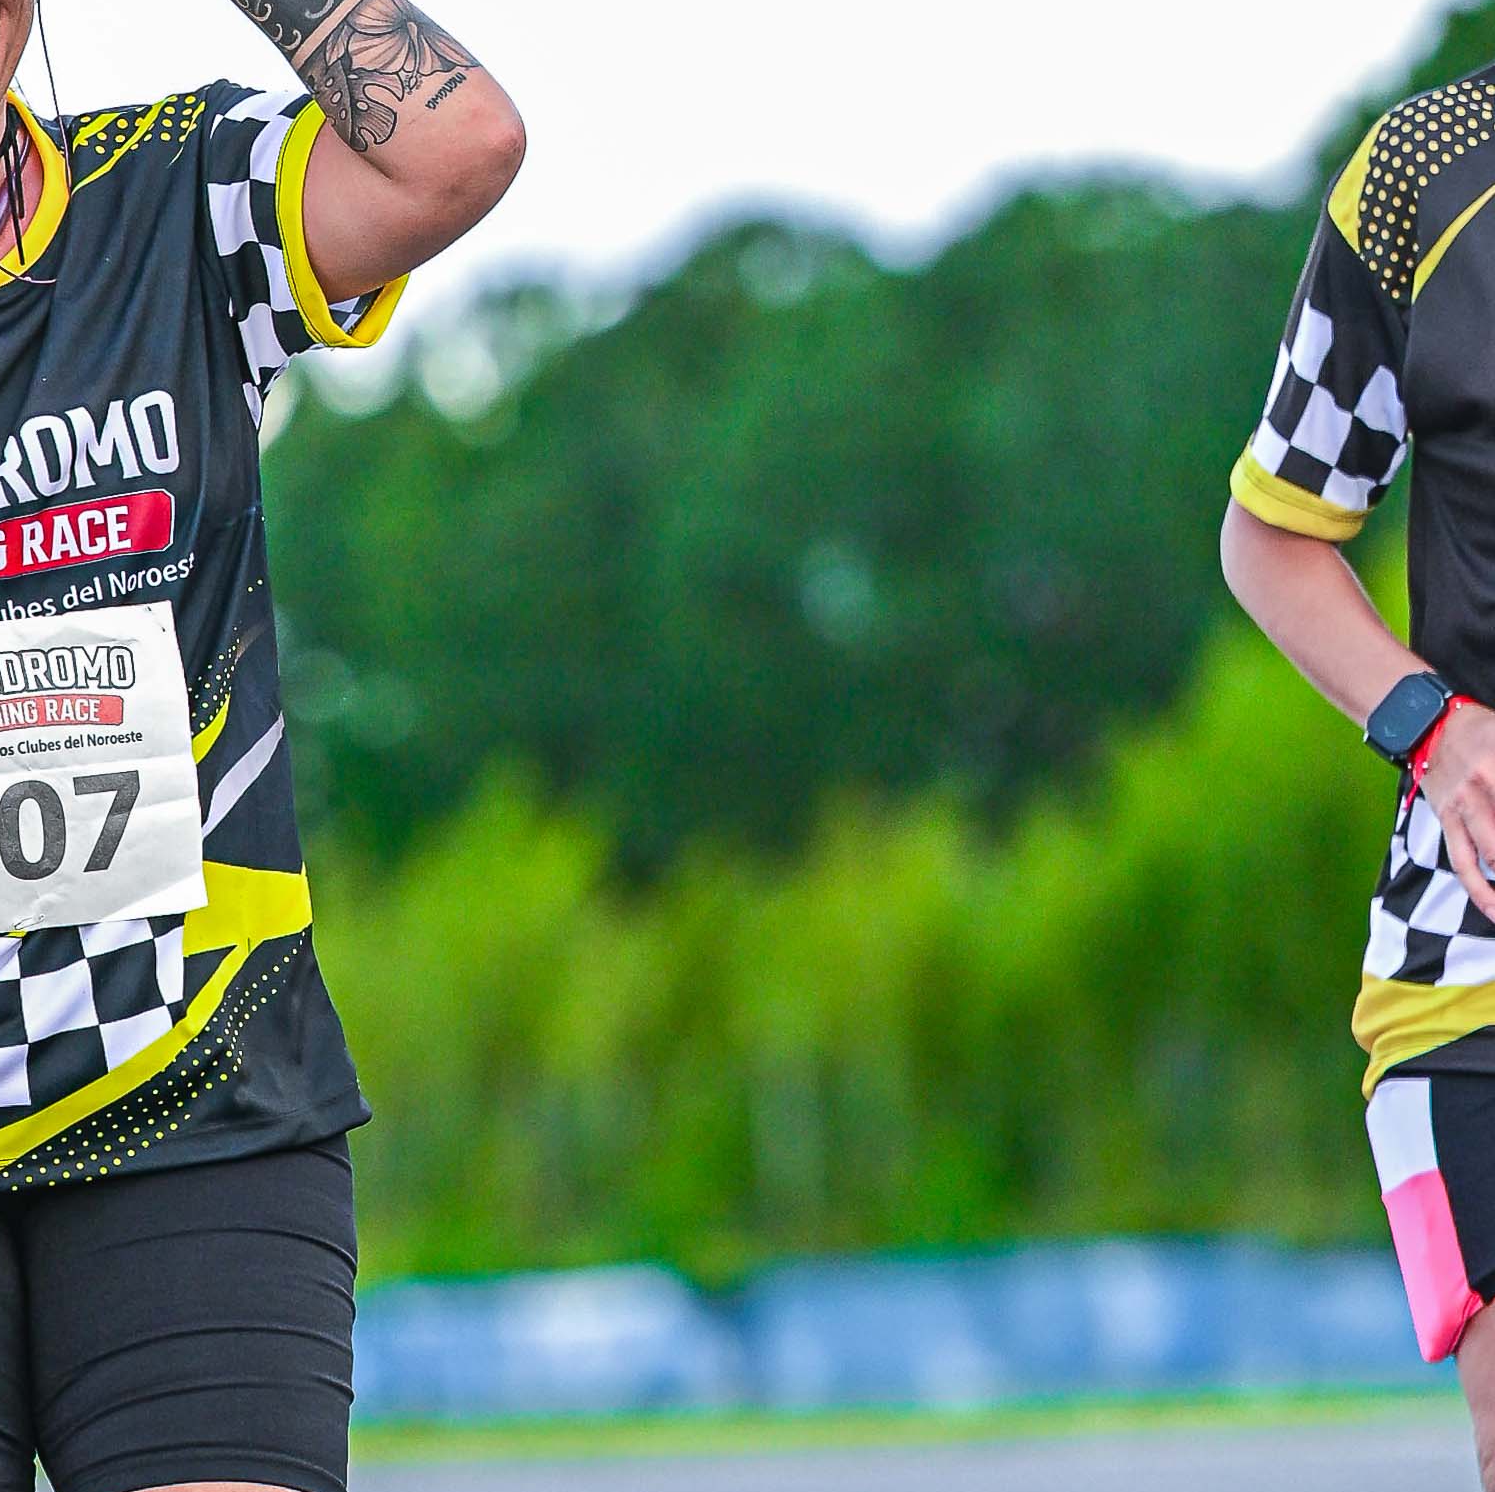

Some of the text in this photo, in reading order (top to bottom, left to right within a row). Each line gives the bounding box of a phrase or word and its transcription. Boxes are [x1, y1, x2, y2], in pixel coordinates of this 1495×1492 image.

[21, 505, 132, 567] RACE
[62, 576, 104, 609] del
[45, 697, 101, 723] RACE
[17, 739, 62, 756] Clubes
[63, 736, 85, 750] del
[86, 730, 143, 747] Noroeste
